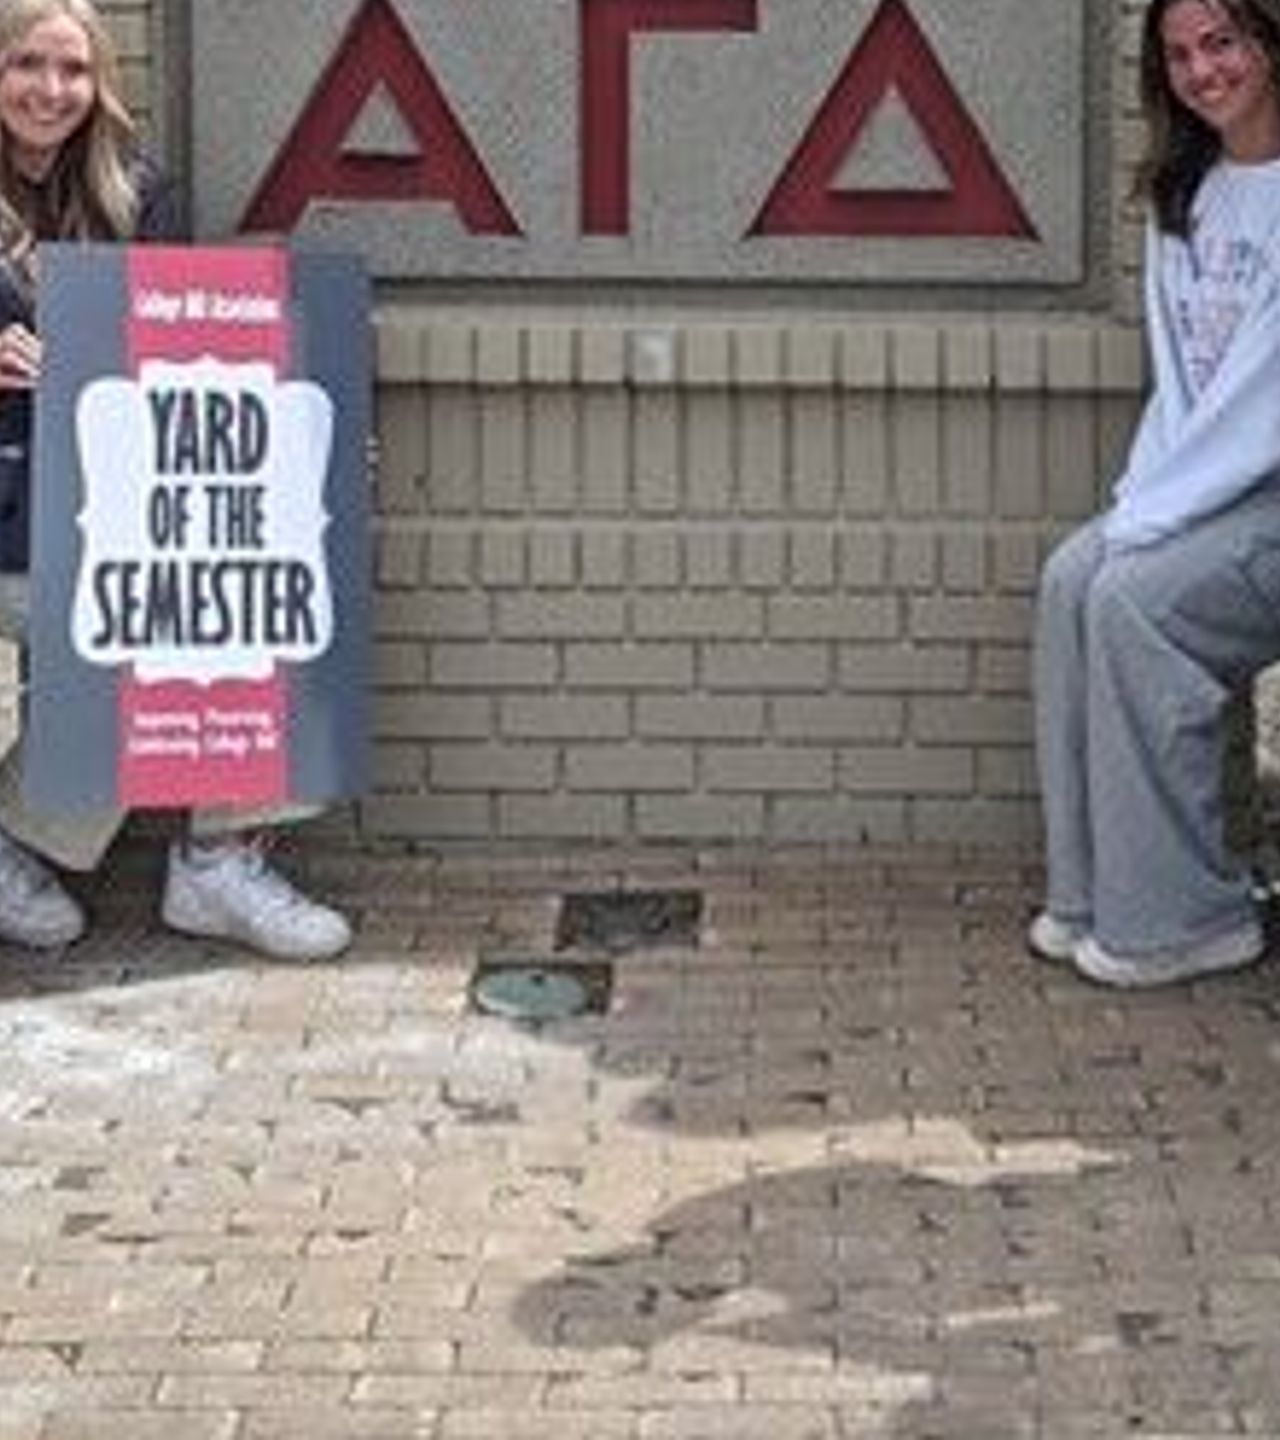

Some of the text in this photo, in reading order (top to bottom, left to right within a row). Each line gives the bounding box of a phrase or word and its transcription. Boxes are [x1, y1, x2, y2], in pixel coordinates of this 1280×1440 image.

[148, 385, 269, 476] YARD
[147, 484, 266, 550] OF THE
[92, 558, 318, 650] SEMESTER
